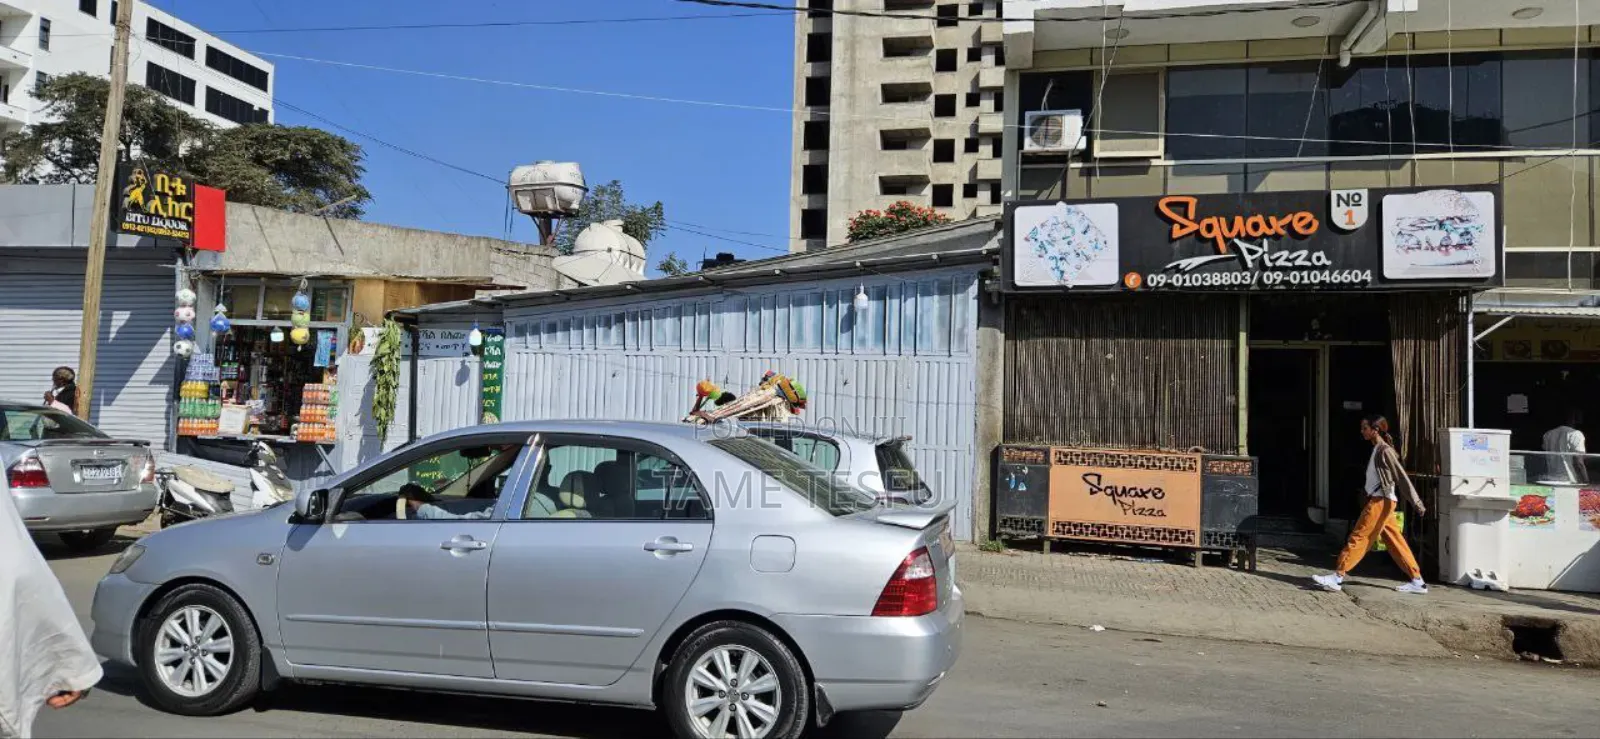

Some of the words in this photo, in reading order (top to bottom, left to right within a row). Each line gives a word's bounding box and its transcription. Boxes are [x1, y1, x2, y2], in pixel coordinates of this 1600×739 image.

[126, 212, 149, 224] BITU
[153, 217, 188, 229] LIQUOR
[1158, 195, 1319, 254] Square
[1344, 209, 1356, 226] 1
[1233, 238, 1331, 268] Pizza
[1263, 269, 1372, 286] 09-01046604
[1081, 473, 1165, 505] Square
[1118, 499, 1167, 517] Pizza
